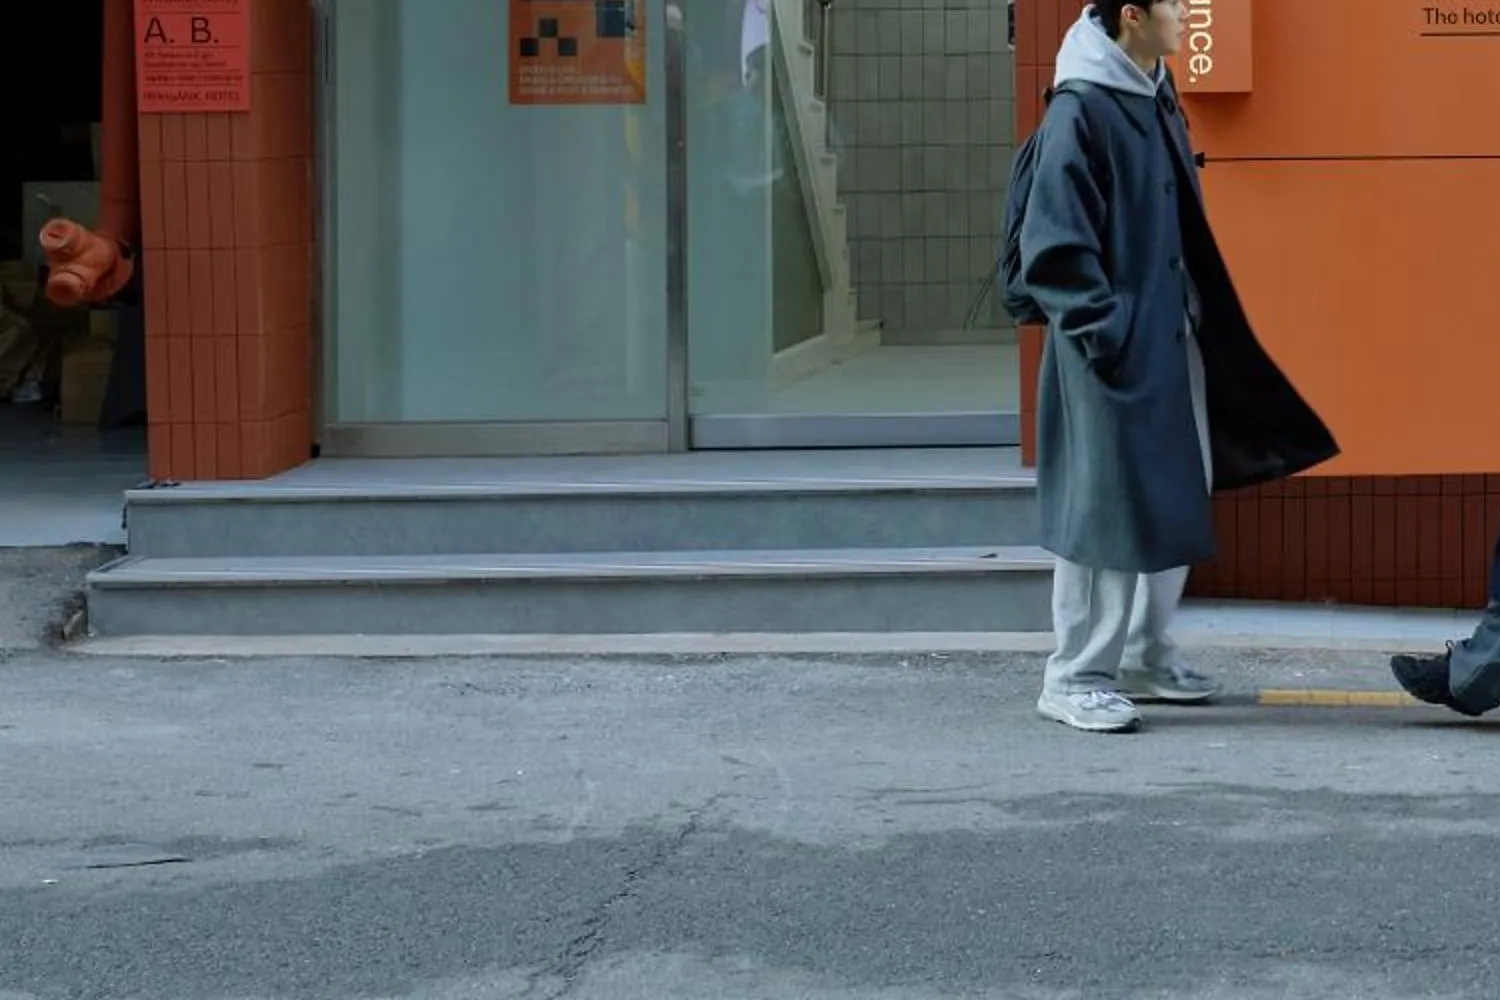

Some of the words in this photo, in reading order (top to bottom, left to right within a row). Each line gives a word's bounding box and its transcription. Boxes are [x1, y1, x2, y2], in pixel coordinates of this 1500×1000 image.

[1422, 7, 1459, 25] The
[143, 16, 175, 44] A.
[190, 16, 219, 44] B.
